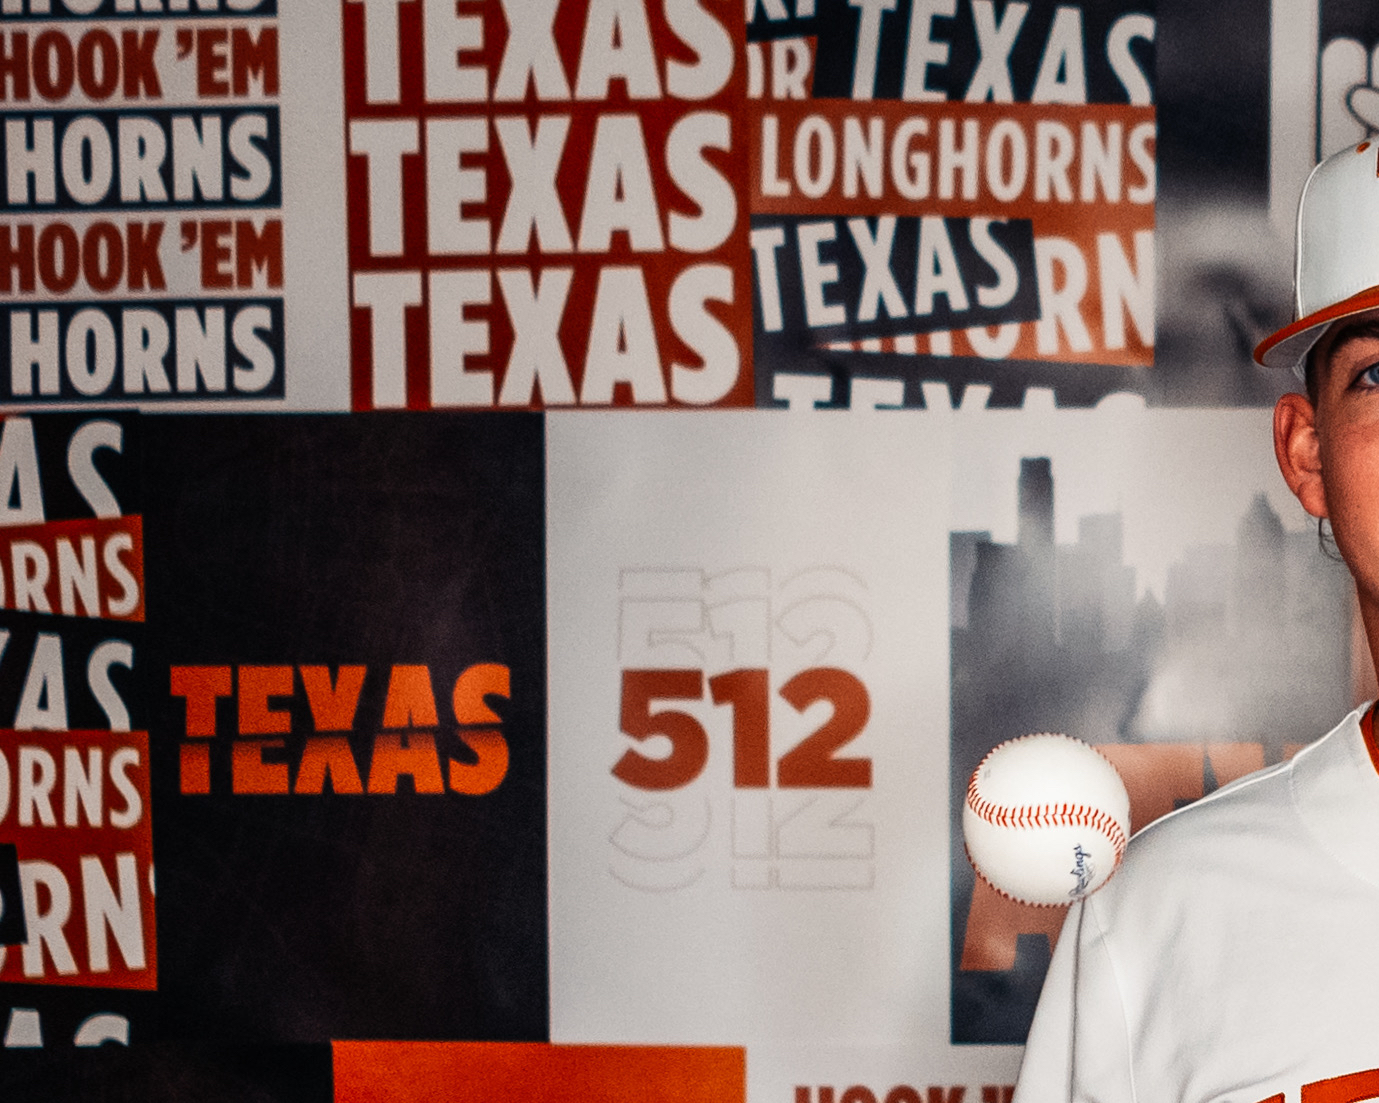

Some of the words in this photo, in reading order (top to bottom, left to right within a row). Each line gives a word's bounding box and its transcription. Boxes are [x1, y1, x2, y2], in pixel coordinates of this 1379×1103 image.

[0, 28, 162, 101] HOOK
[345, 0, 734, 103] TEXAS
[848, 0, 1156, 106] TEXAS
[5, 114, 273, 205] HORNS
[350, 111, 737, 256] TEXAS
[760, 113, 1156, 204] LONGHORNS
[0, 221, 165, 295] HOOK
[750, 215, 1019, 332] TEXAS
[9, 305, 276, 396] HORNS
[353, 263, 741, 410] TEXAS
[611, 666, 872, 792] 512
